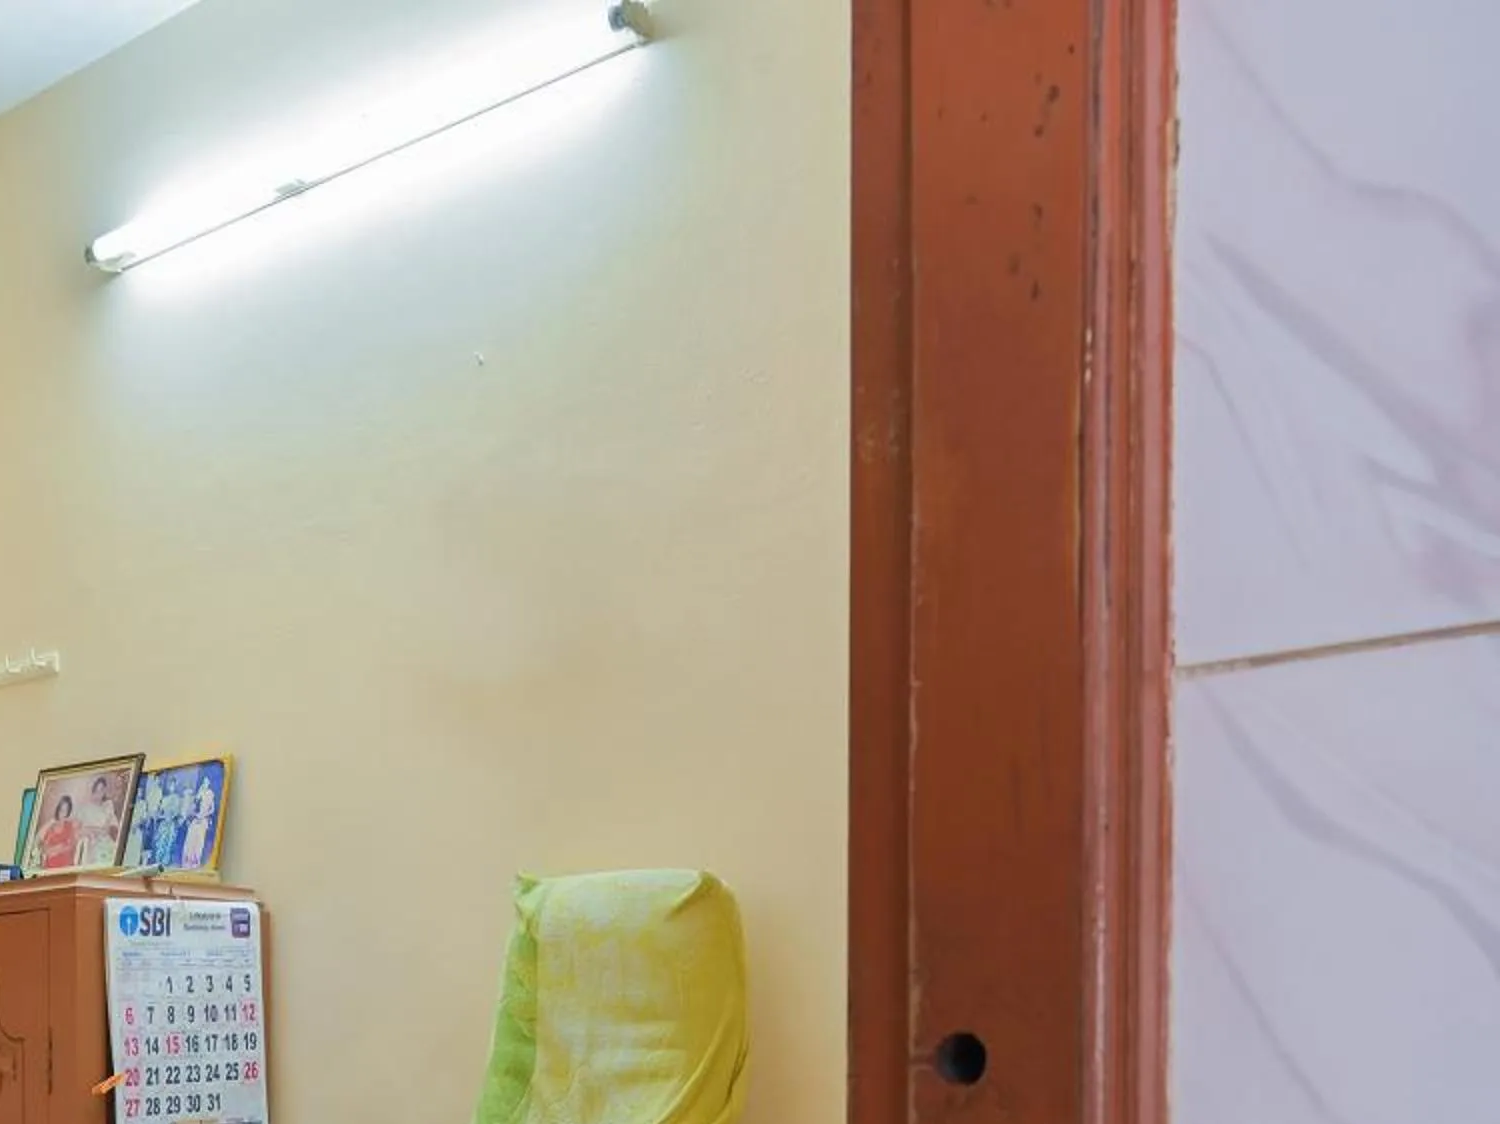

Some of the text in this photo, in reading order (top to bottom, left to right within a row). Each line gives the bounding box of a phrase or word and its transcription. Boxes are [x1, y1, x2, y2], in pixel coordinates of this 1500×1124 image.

[140, 906, 171, 937] SBI
[166, 974, 251, 993] 1 2 3 4 5
[125, 1003, 256, 1025] 6 7 8 9 10 11 12
[124, 1032, 257, 1056] 13 14 15 16 17 18 19
[125, 1061, 258, 1087] 20 21 22 23 24 25 26
[126, 1094, 221, 1117] 27 28 29 30 31
